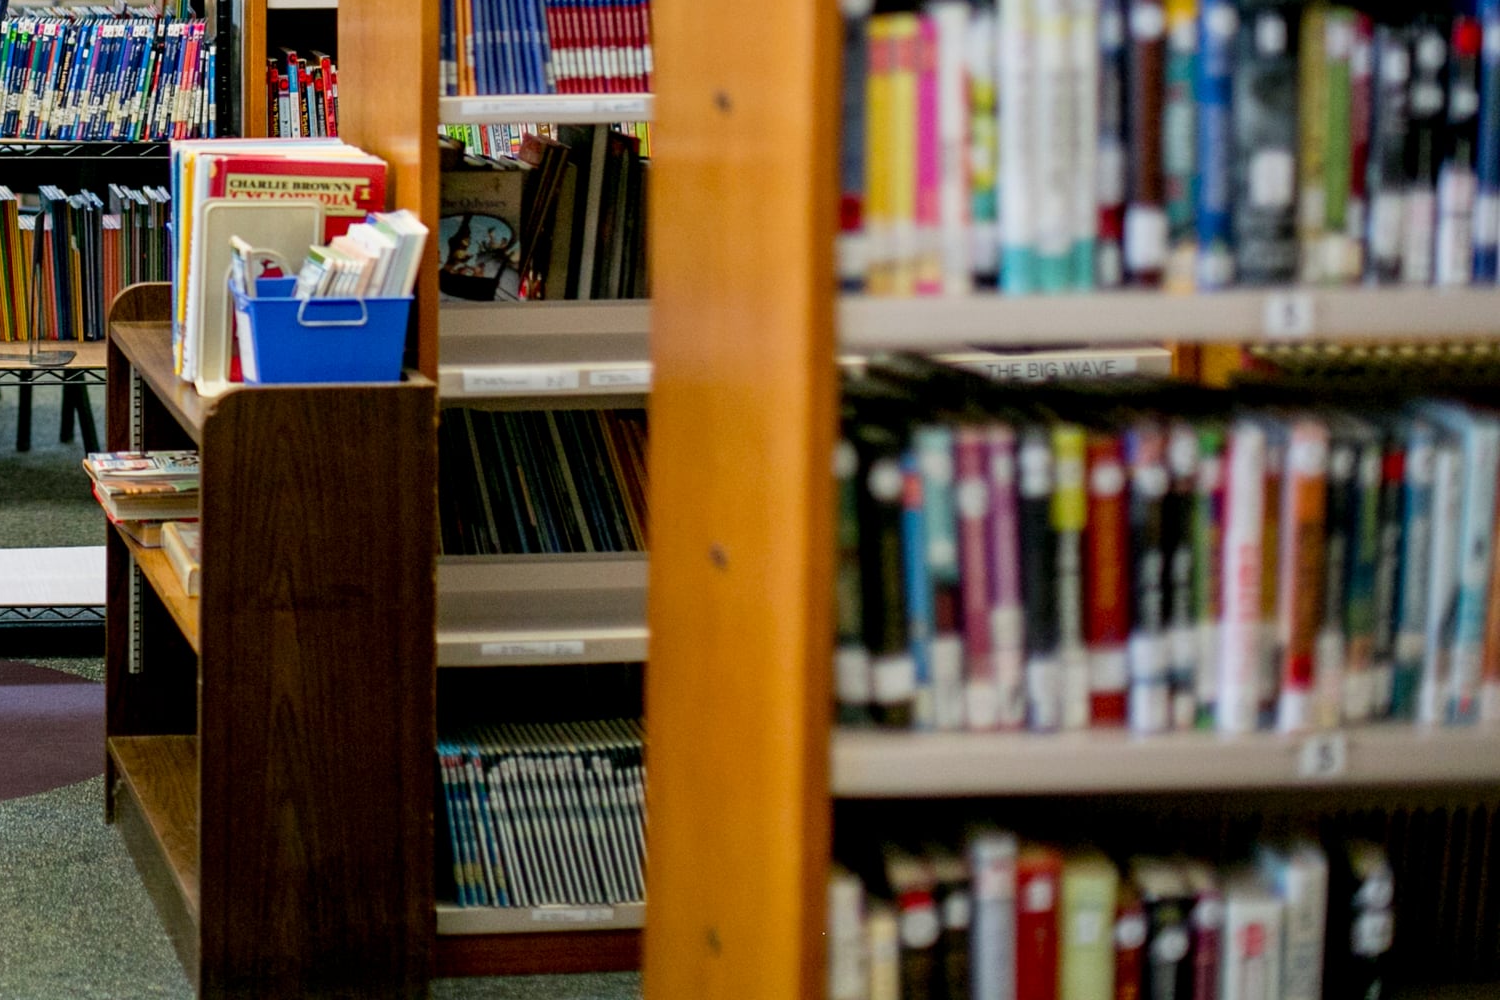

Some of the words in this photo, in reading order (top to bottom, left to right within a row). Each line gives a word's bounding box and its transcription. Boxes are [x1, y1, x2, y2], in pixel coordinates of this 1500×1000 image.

[230, 178, 290, 190] CHARLIE
[292, 179, 351, 192] BROWN'S
[986, 363, 1022, 381] THE
[1027, 361, 1058, 379] BIG
[1063, 359, 1118, 377] WAVE
